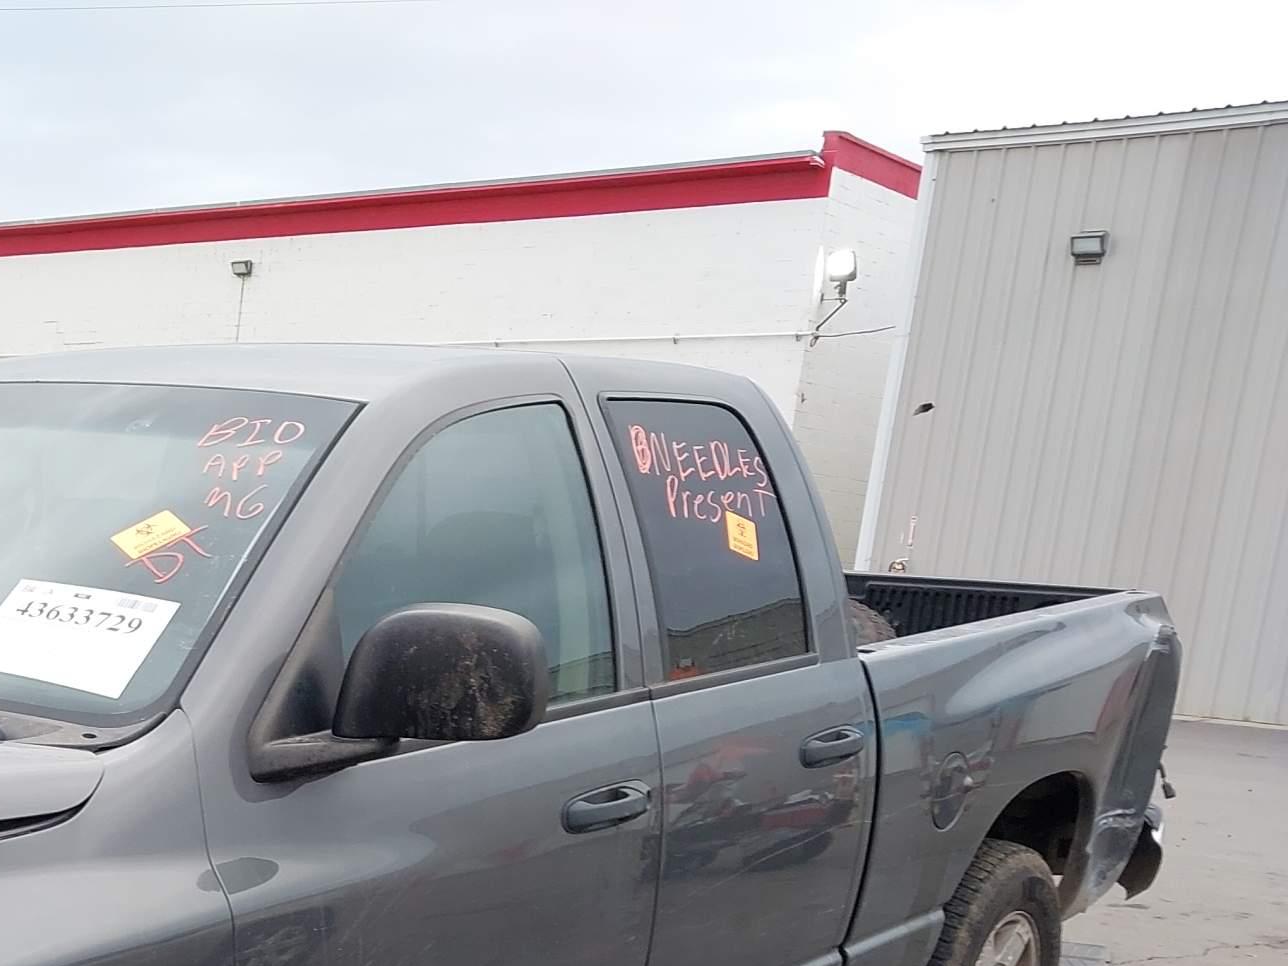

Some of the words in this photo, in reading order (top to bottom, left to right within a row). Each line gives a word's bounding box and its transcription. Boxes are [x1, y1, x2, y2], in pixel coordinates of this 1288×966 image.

[198, 417, 304, 448] BIO
[203, 450, 282, 481] APP
[16, 600, 143, 634] 43633729
